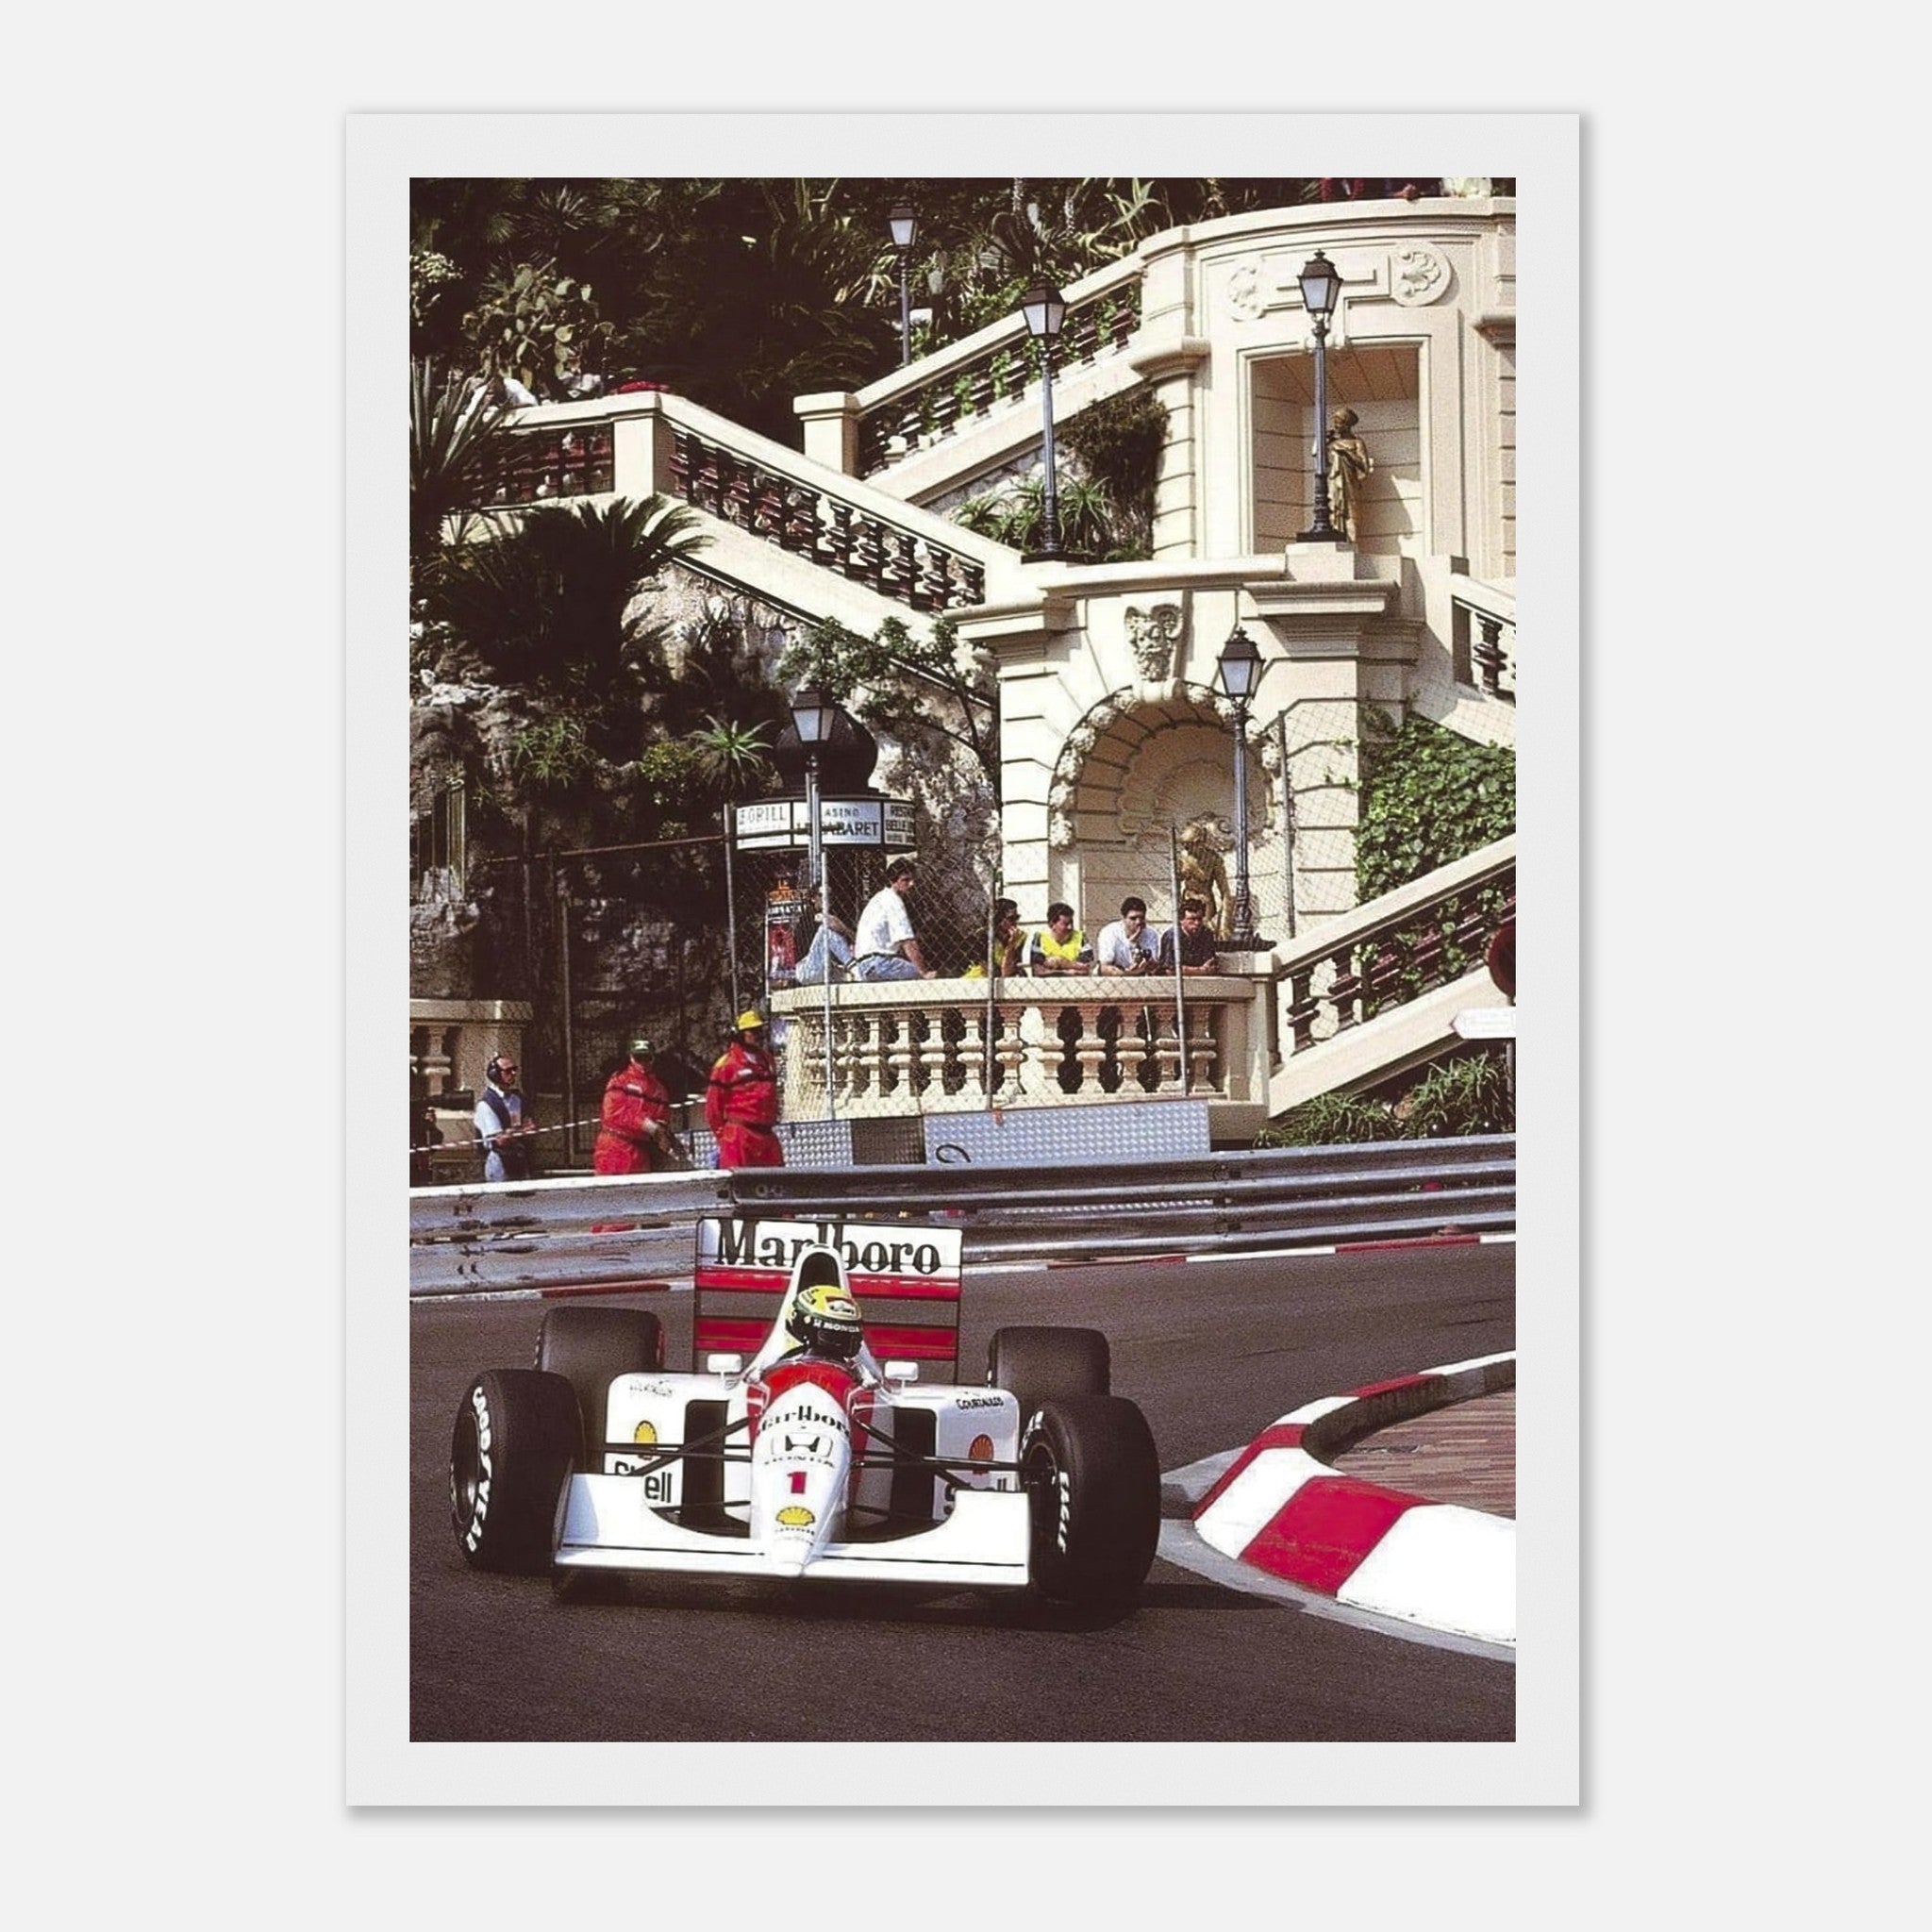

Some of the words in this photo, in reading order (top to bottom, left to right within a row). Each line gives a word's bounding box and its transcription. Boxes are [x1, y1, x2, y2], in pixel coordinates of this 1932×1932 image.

[824, 808, 860, 817] ASINO
[821, 821, 879, 837] ABARET
[787, 1472, 808, 1493] 1
